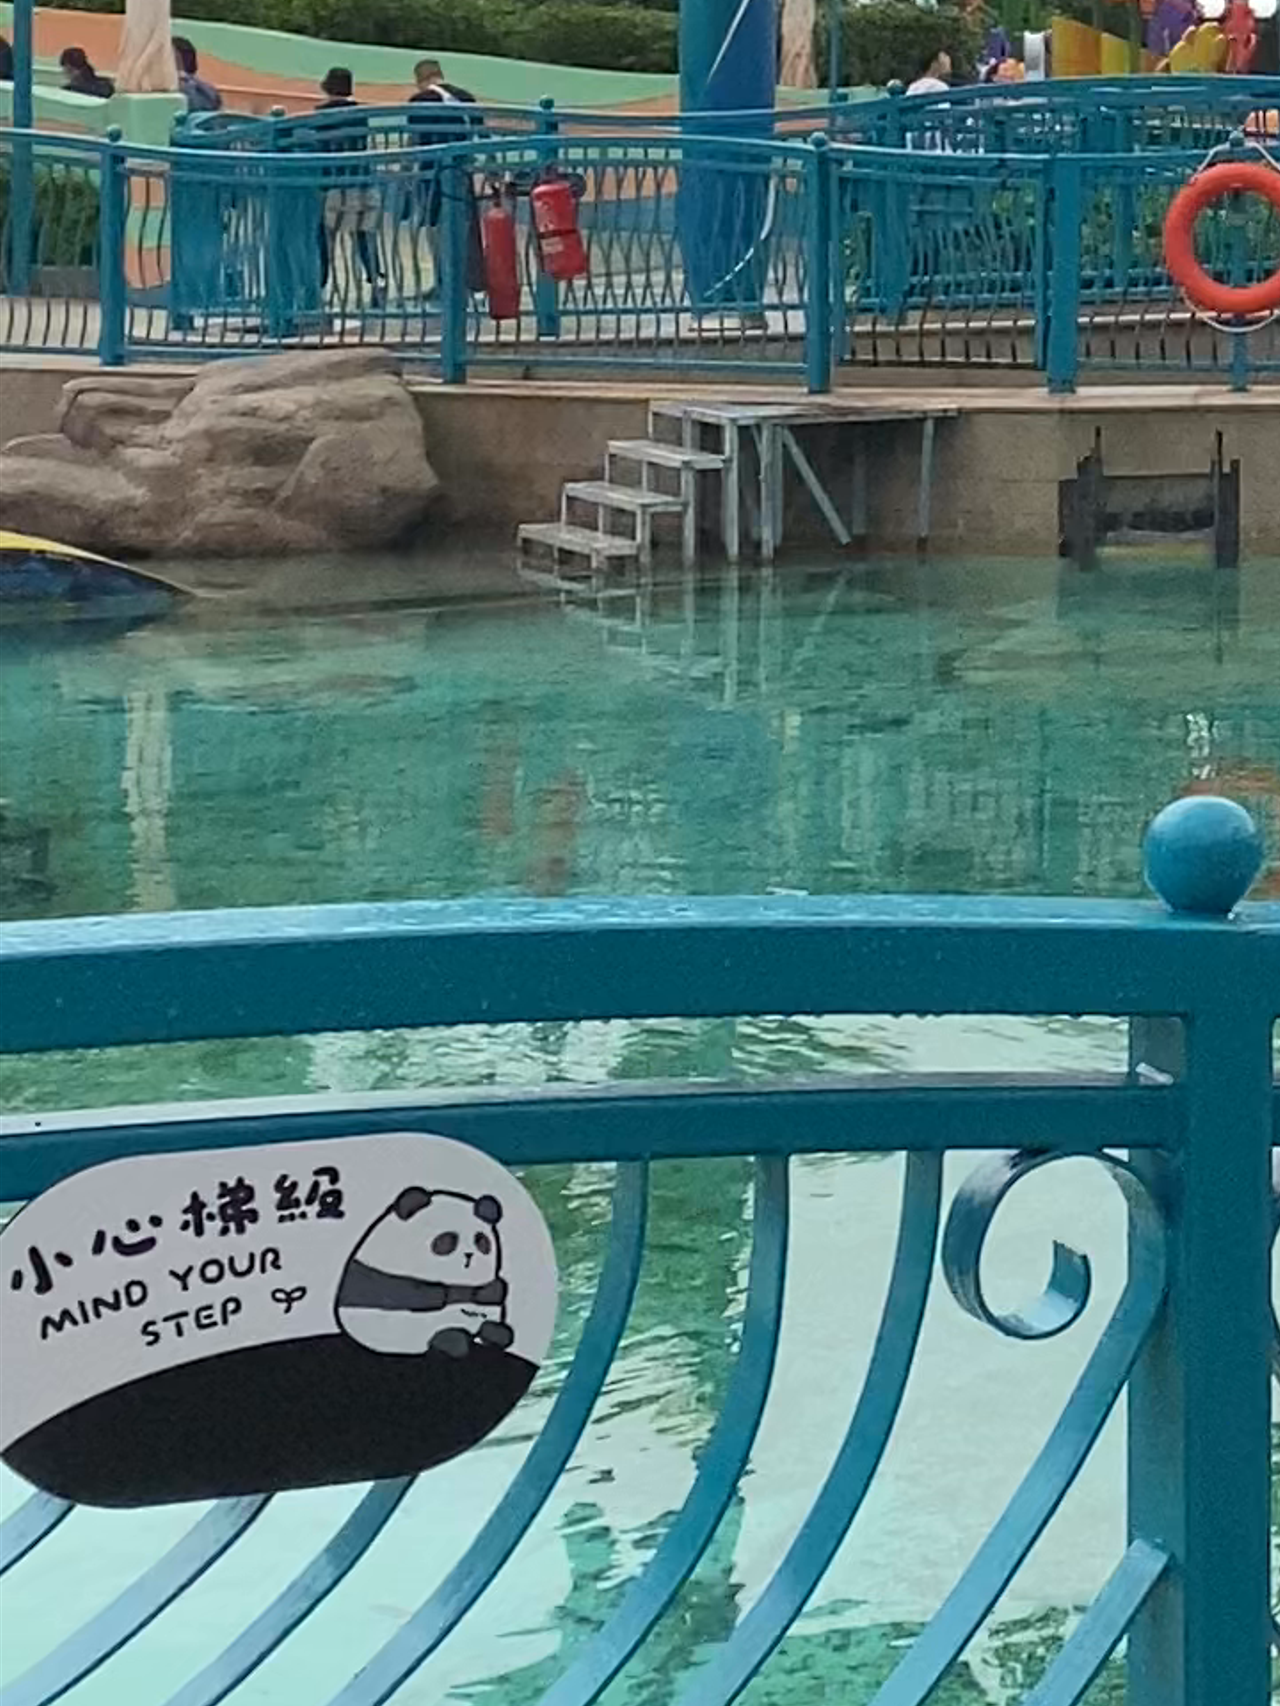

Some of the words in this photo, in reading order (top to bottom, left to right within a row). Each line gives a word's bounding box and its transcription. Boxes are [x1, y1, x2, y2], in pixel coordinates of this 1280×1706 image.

[41, 1280, 148, 1340] MIND
[168, 1247, 282, 1291] YOUR
[141, 1296, 241, 1346] STEP
